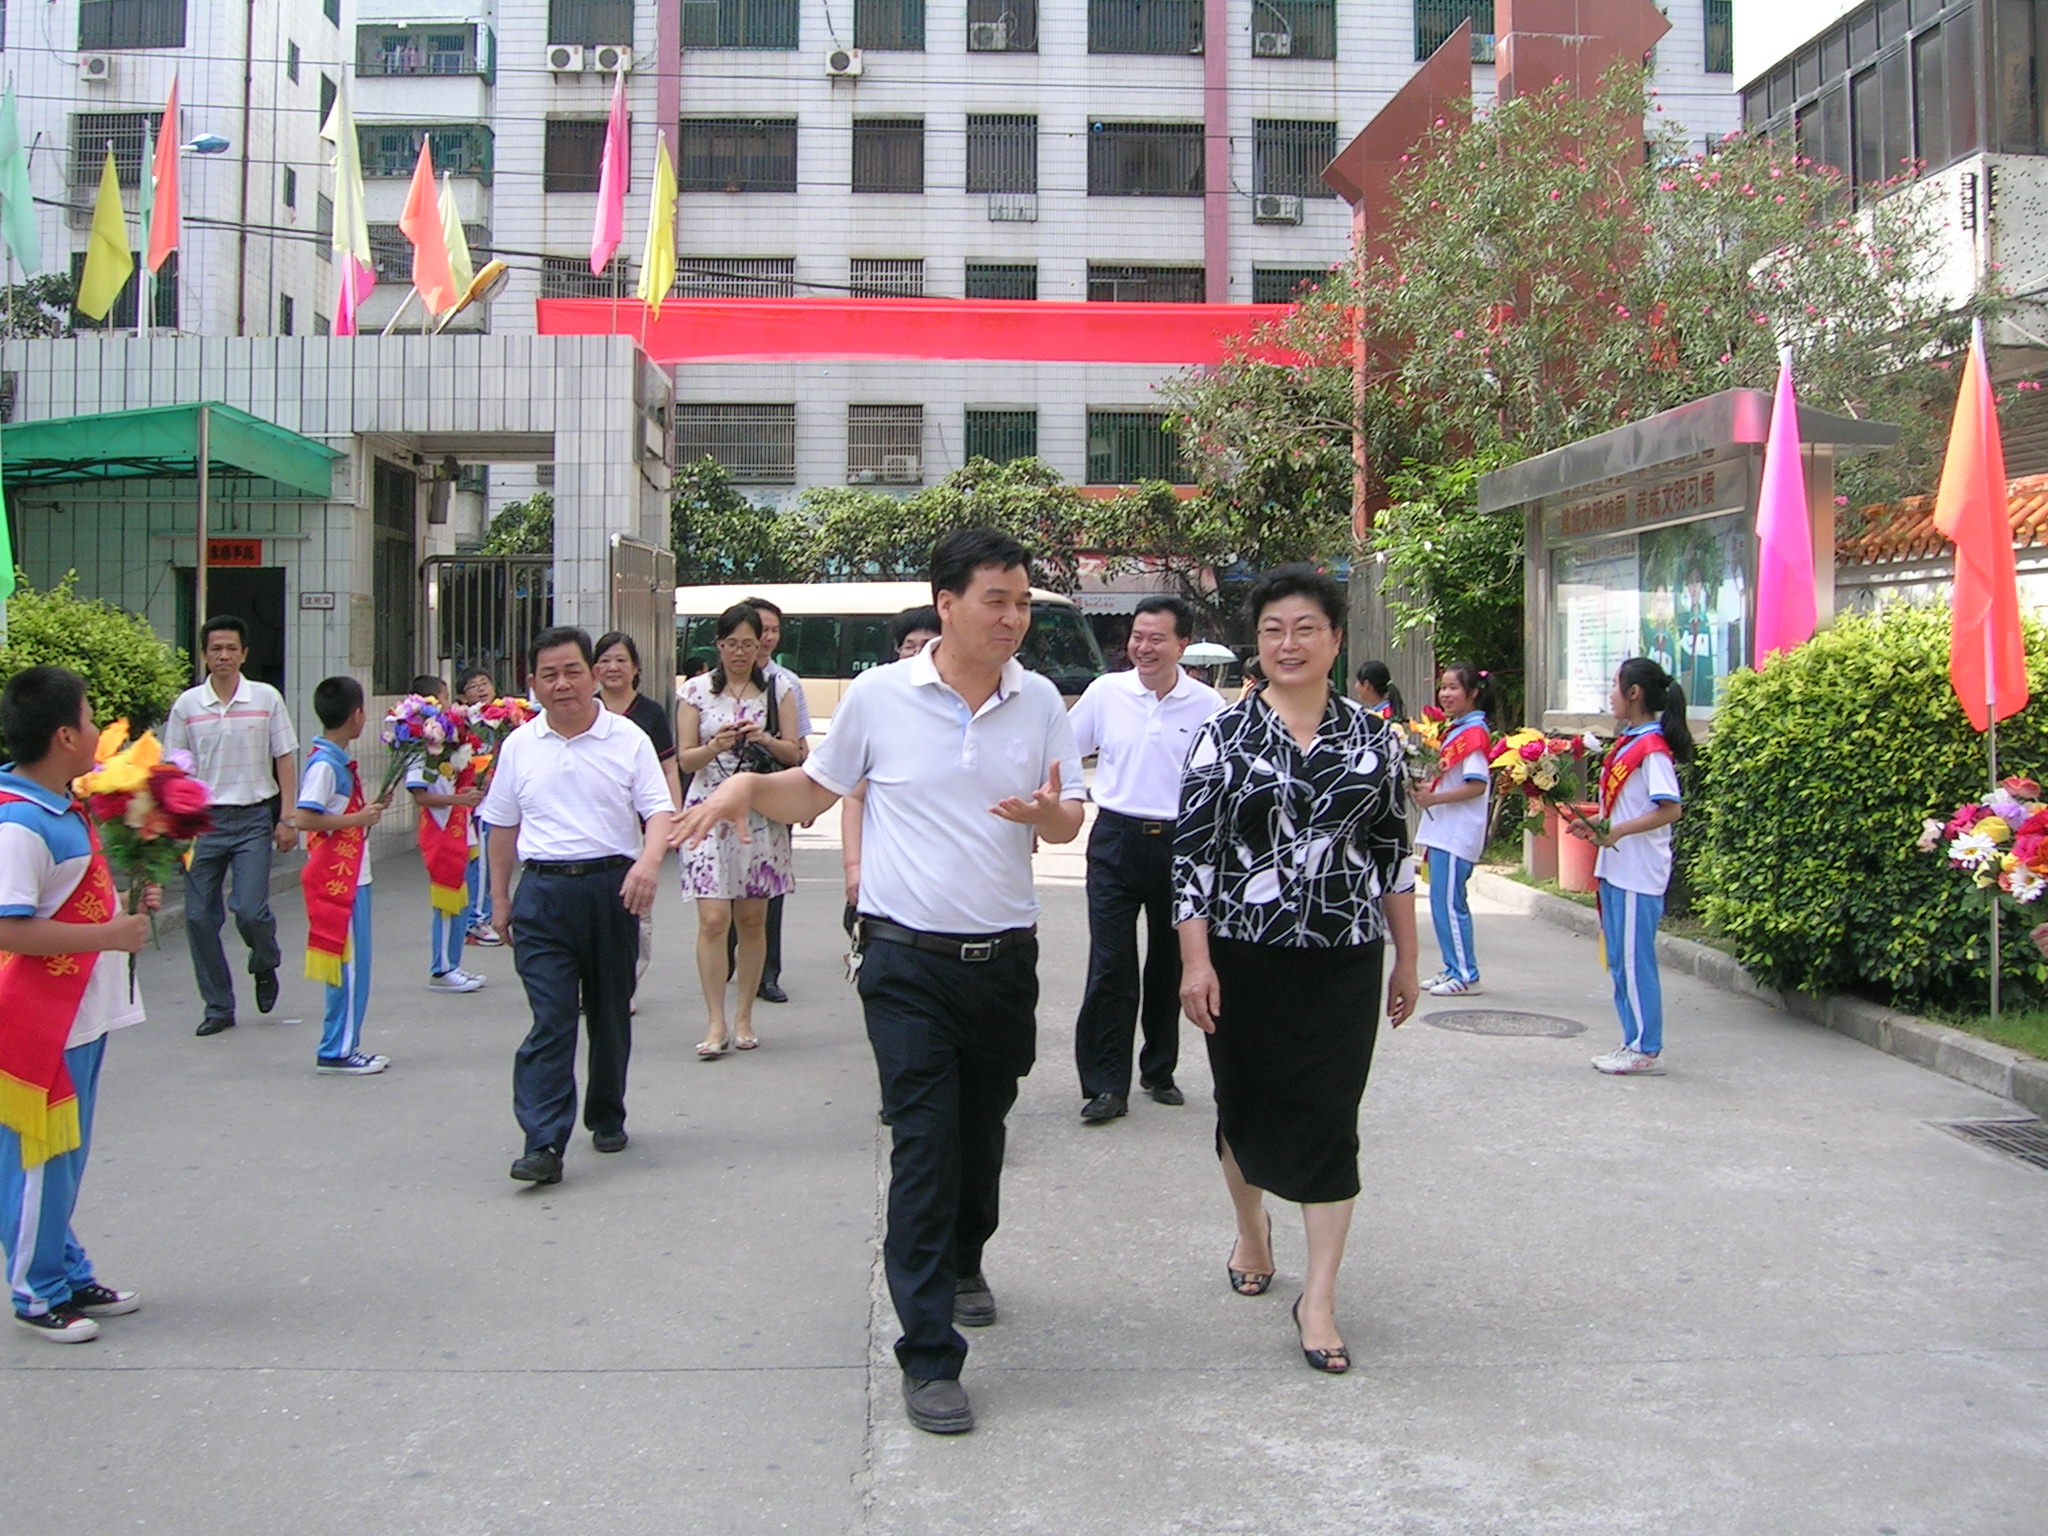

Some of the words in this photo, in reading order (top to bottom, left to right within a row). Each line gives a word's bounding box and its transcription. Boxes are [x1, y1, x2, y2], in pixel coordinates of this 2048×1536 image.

[1635, 470, 1716, 521] 养成文明习惯
